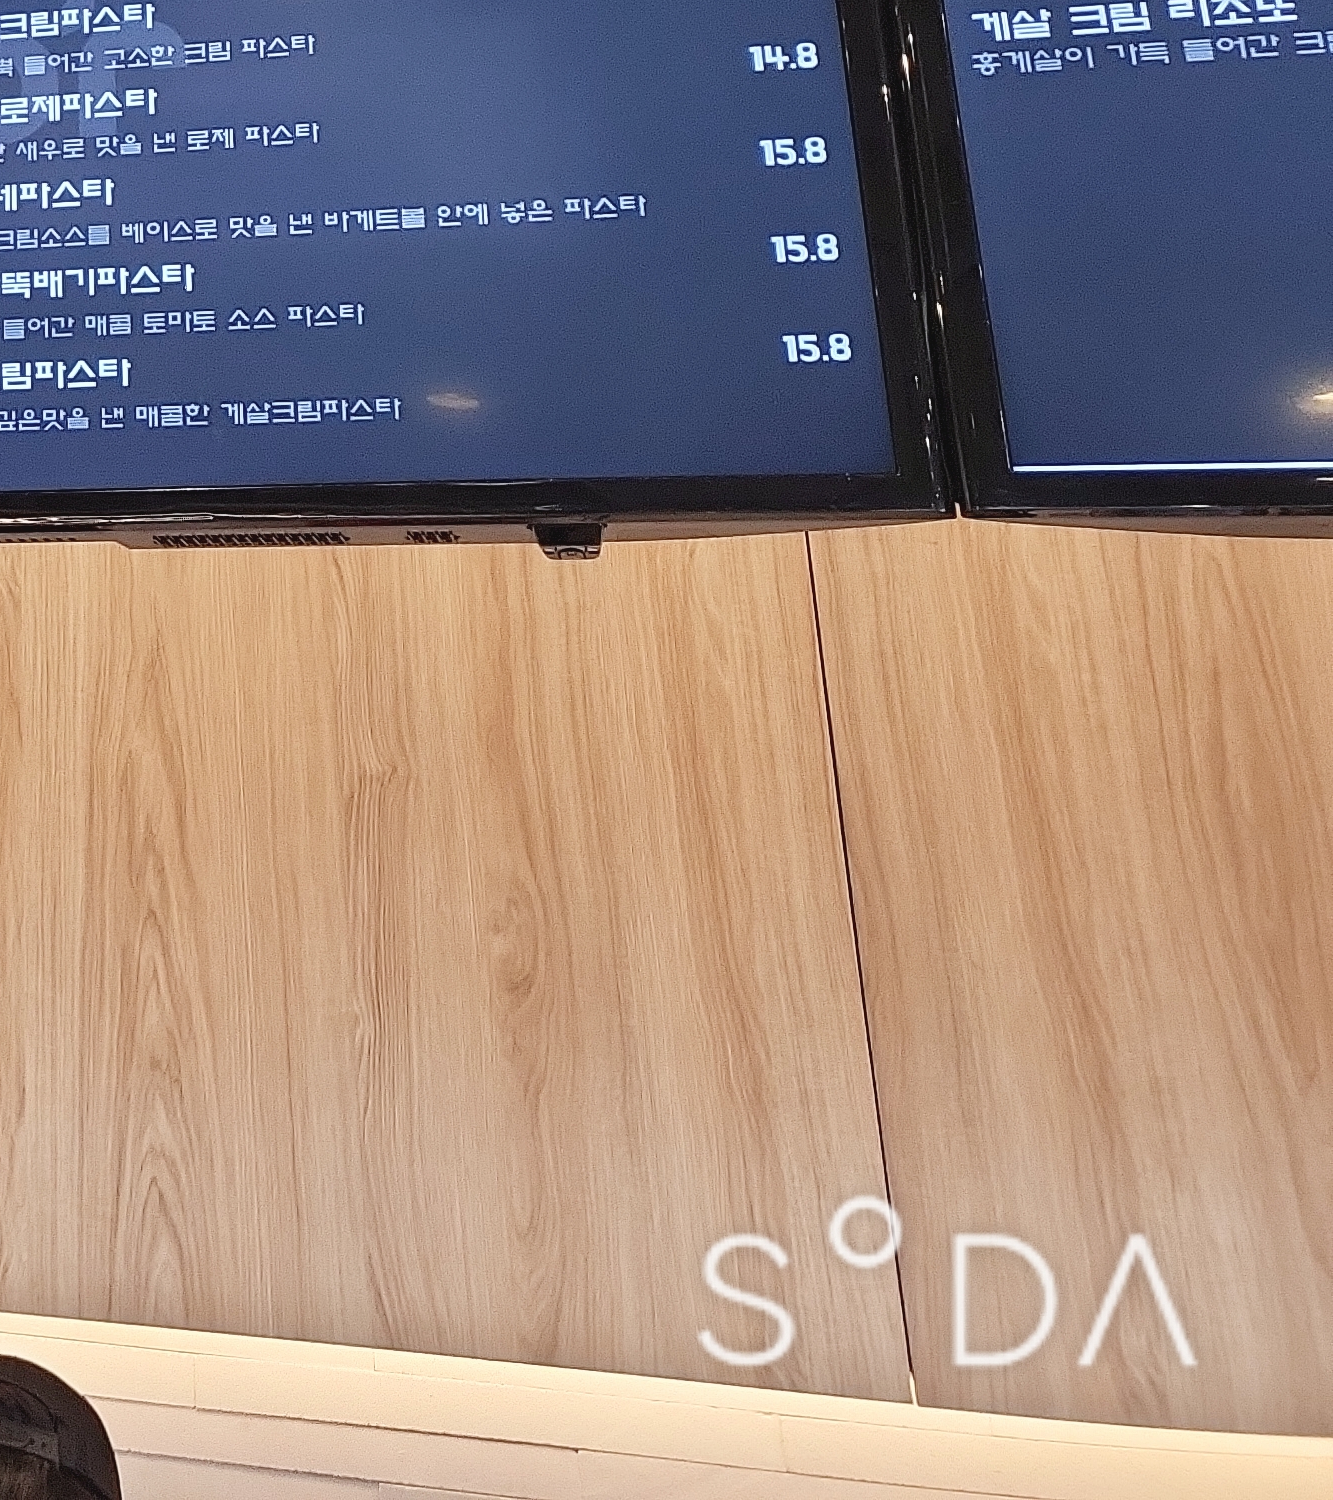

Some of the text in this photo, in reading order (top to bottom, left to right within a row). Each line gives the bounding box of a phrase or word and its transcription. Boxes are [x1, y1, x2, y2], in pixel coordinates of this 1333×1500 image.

[0, 4, 155, 40] 크림파스타
[972, 9, 1051, 41] 게살
[1069, 2, 1150, 35] 크림
[749, 43, 818, 71] 14.8
[1, 89, 157, 124] 로제파스타
[760, 137, 826, 165] 15.8
[771, 234, 838, 262] 15.8
[2, 264, 194, 298] 뚝배기파스타
[783, 334, 851, 362] 15.8
